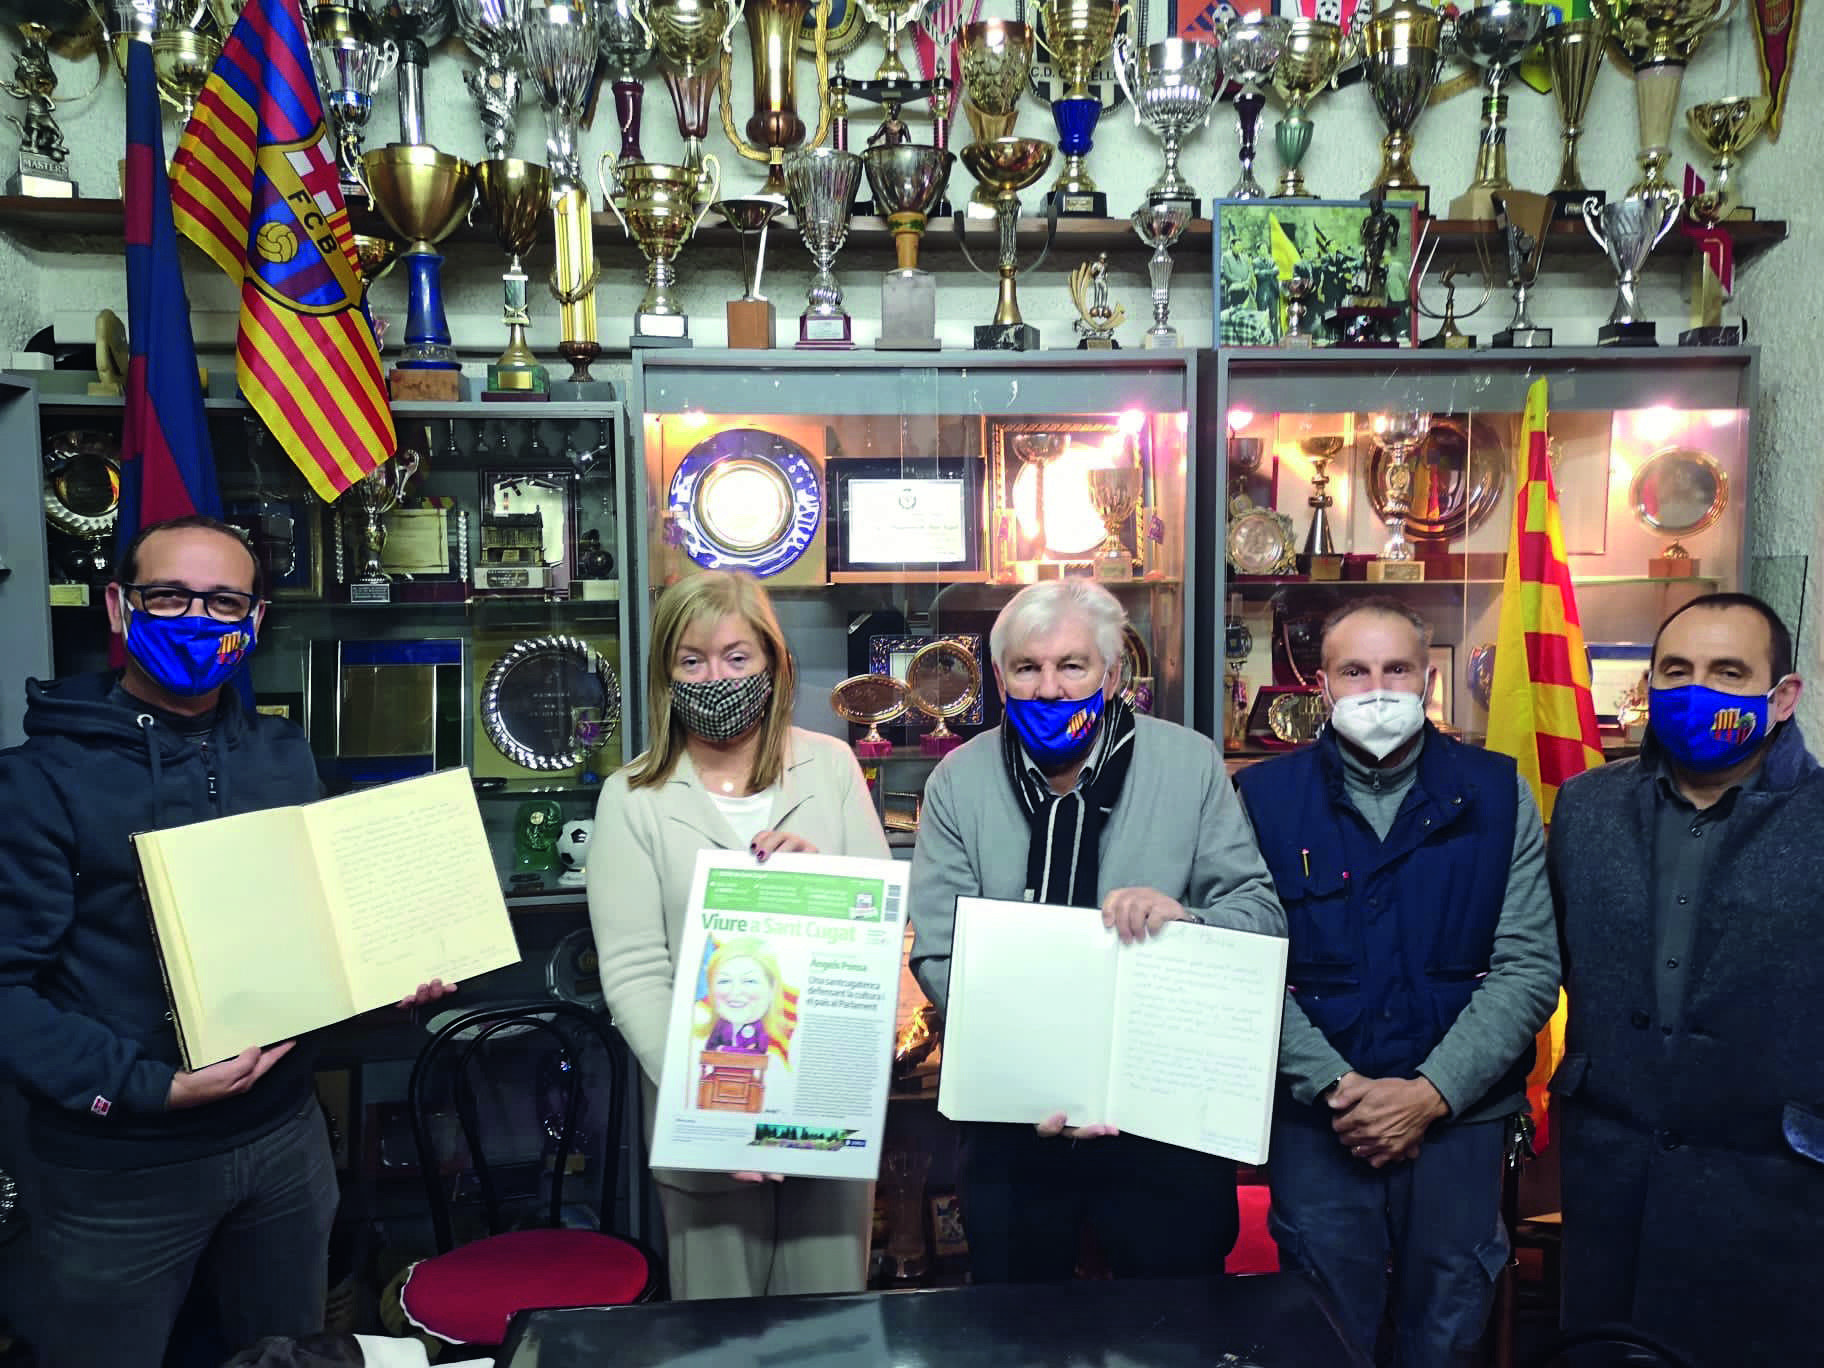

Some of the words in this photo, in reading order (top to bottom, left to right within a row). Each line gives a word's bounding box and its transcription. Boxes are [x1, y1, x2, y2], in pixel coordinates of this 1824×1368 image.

[702, 912, 748, 932] Viure
[750, 919, 760, 932] a
[763, 918, 801, 937] Sant
[806, 921, 856, 944] Cugat
